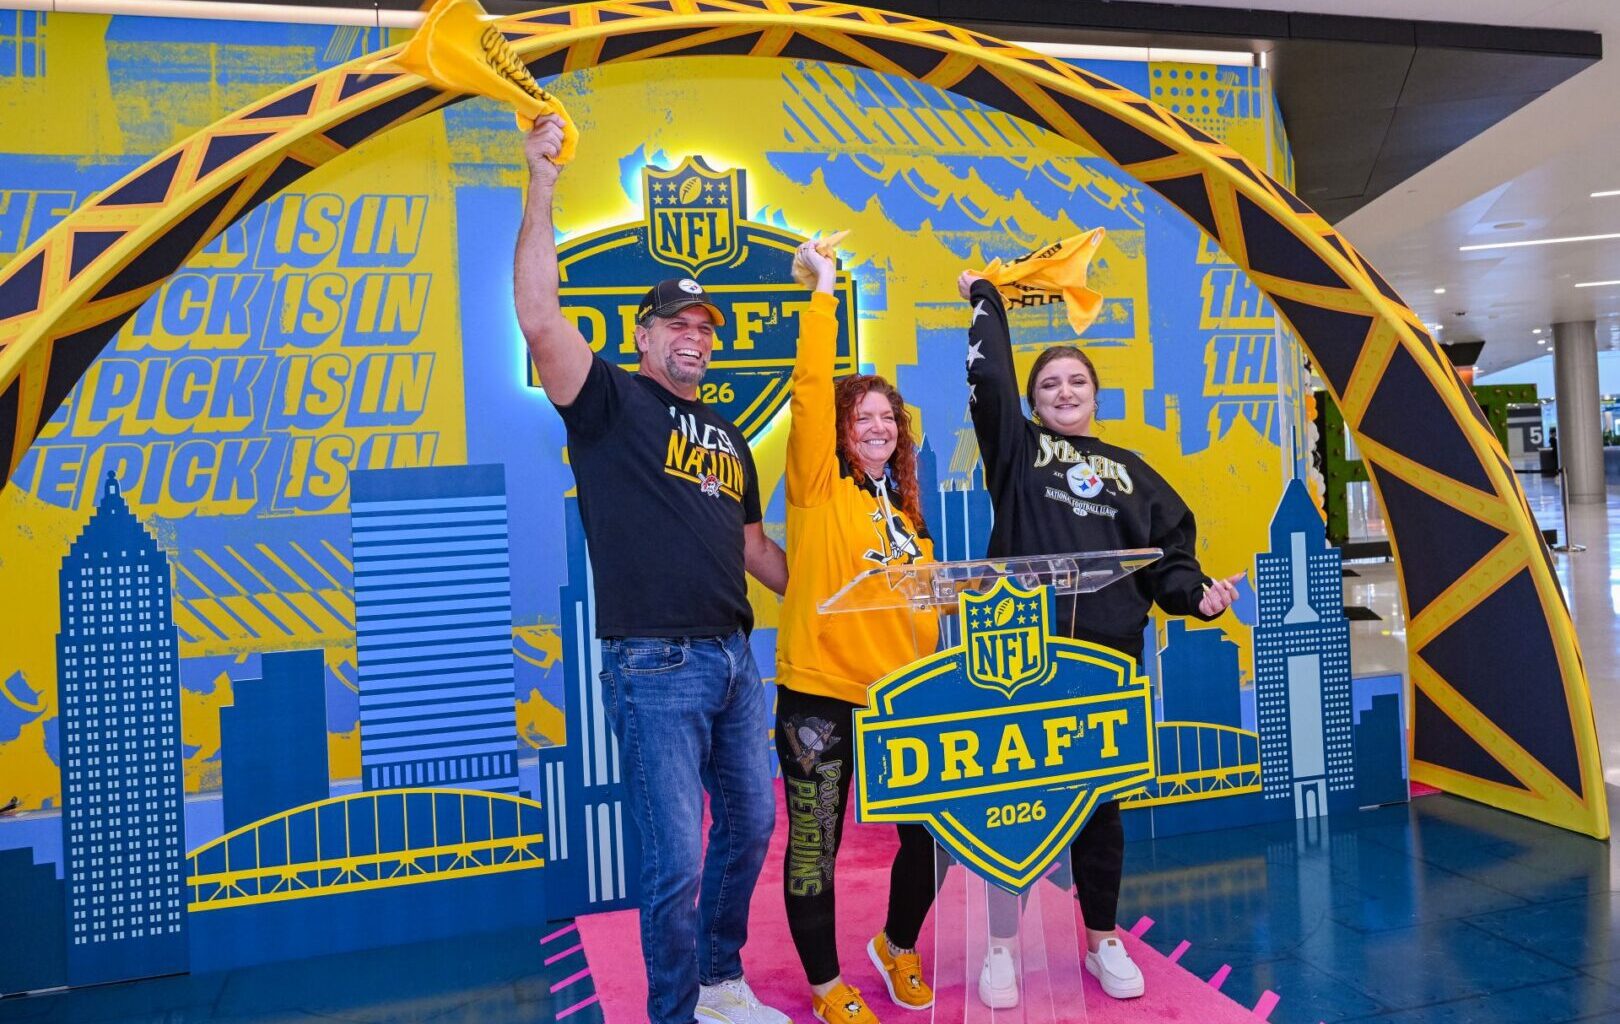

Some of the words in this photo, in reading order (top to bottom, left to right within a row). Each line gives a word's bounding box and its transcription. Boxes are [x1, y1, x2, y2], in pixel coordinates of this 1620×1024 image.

[264, 194, 343, 263] IS
[344, 195, 429, 261] IN
[657, 211, 727, 259] NFL
[124, 274, 262, 343] ICK
[270, 273, 347, 342] IS
[349, 274, 432, 340] IN
[80, 356, 266, 429] PICK
[274, 355, 351, 424] IS
[352, 353, 436, 420] IN
[697, 382, 735, 404] 26
[1530, 427, 1542, 444] 5
[88, 439, 268, 510] PICK
[278, 433, 354, 505] IS
[1072, 499, 1100, 514] FOOTBALL
[974, 630, 1038, 681] NFL
[886, 709, 1128, 788] DRAFT
[788, 776, 822, 896] PENGUINS
[986, 800, 1046, 829] 2026
